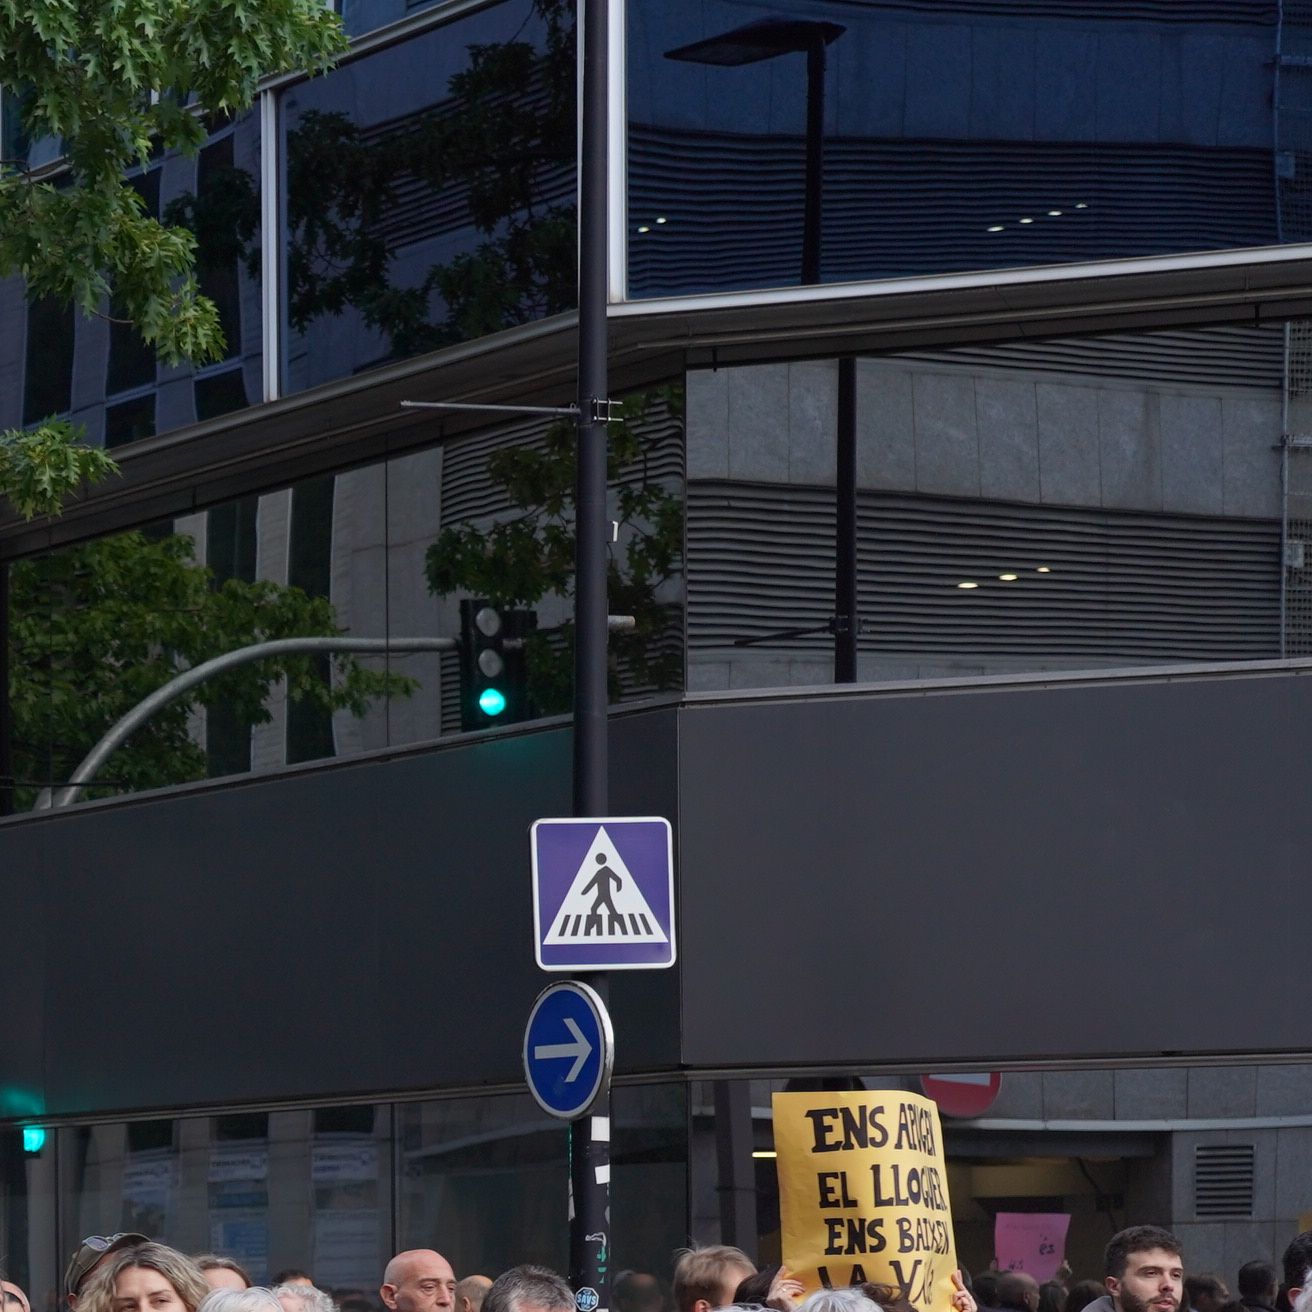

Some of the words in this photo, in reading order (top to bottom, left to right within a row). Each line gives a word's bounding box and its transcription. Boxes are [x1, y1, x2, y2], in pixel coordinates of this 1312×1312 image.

[804, 1105, 889, 1153] ENS
[817, 1171, 858, 1208] EL
[824, 1218, 887, 1255] ENS
